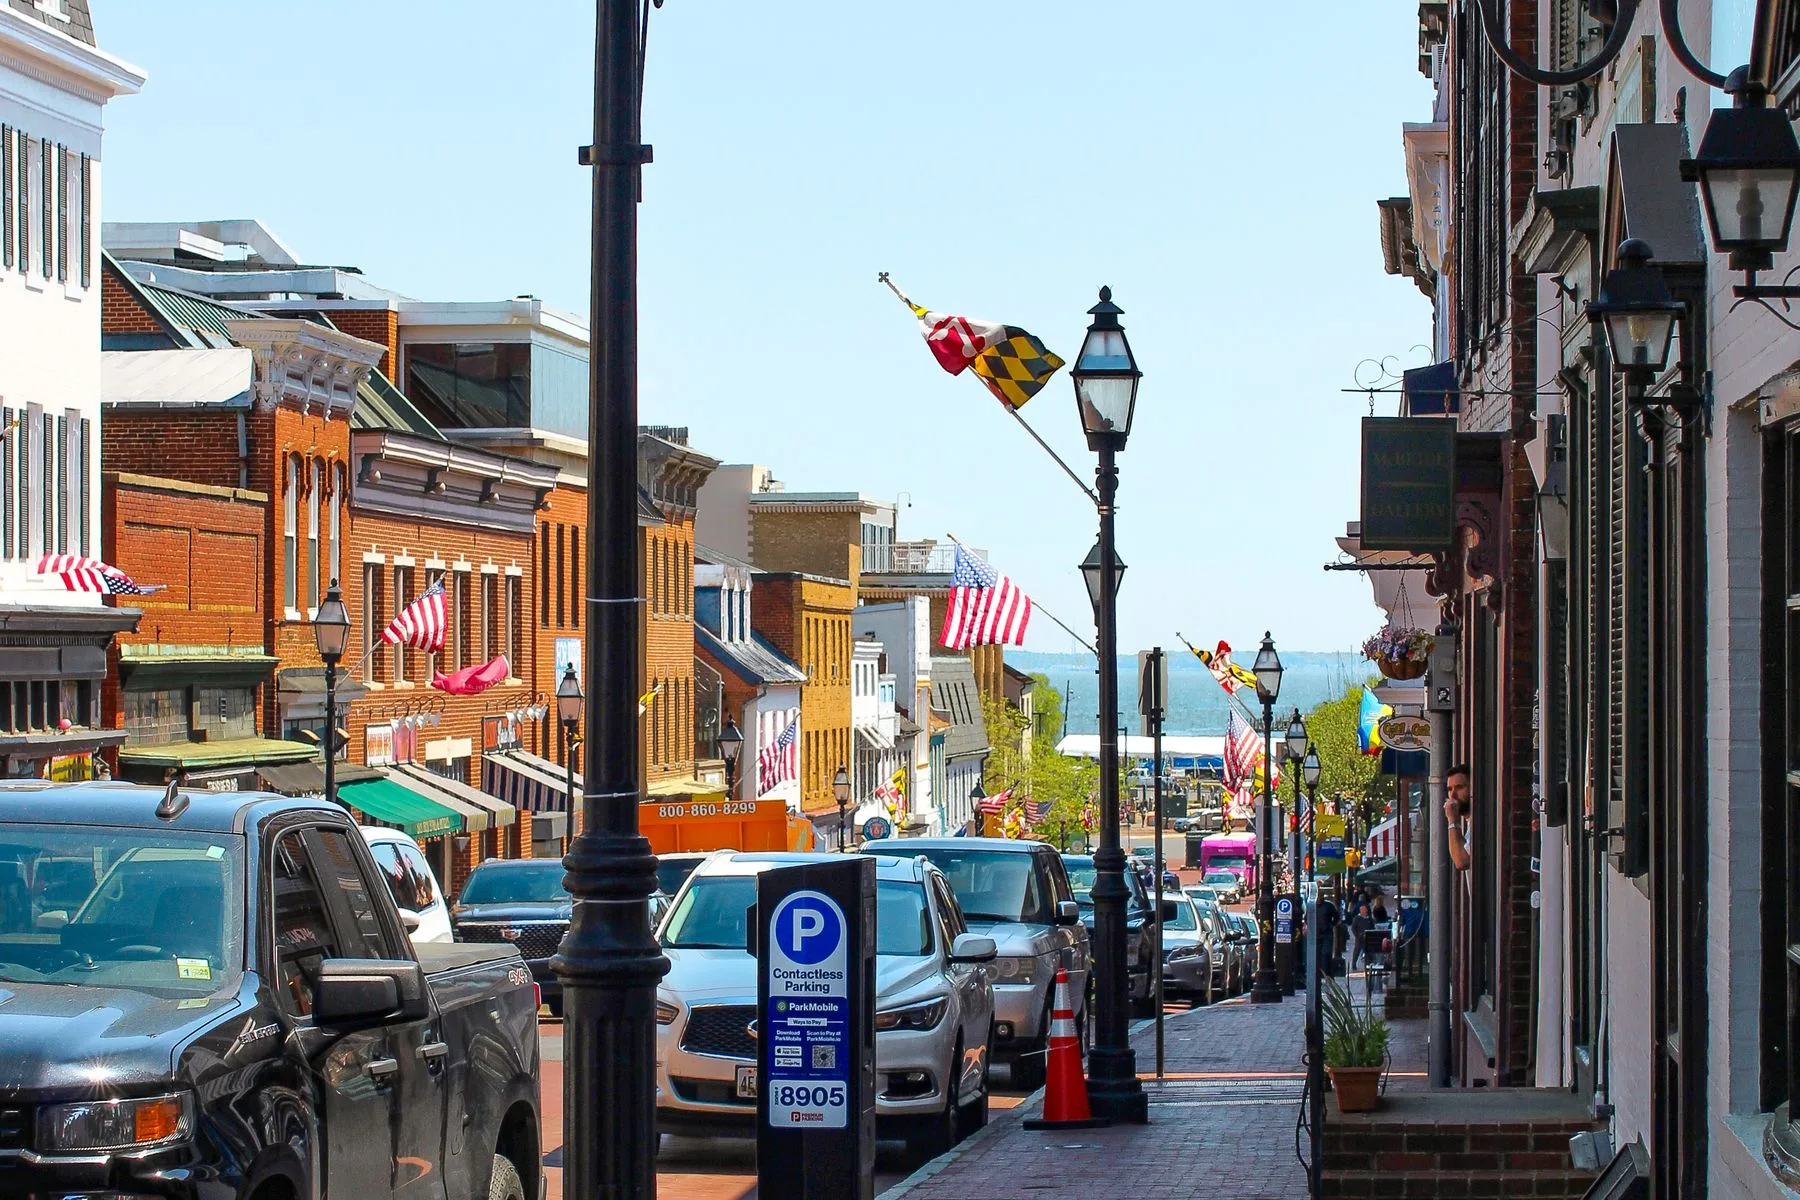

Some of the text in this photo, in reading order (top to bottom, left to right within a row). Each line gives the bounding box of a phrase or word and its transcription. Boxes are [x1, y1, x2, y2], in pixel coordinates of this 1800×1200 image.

[659, 802, 756, 818] 800-860-8299
[1281, 902, 1288, 911] P
[792, 908, 825, 952] P
[773, 968, 843, 980] Contactless
[785, 981, 830, 994] Parking
[789, 1002, 839, 1012] ParkMobile
[780, 1086, 845, 1107] 8905
